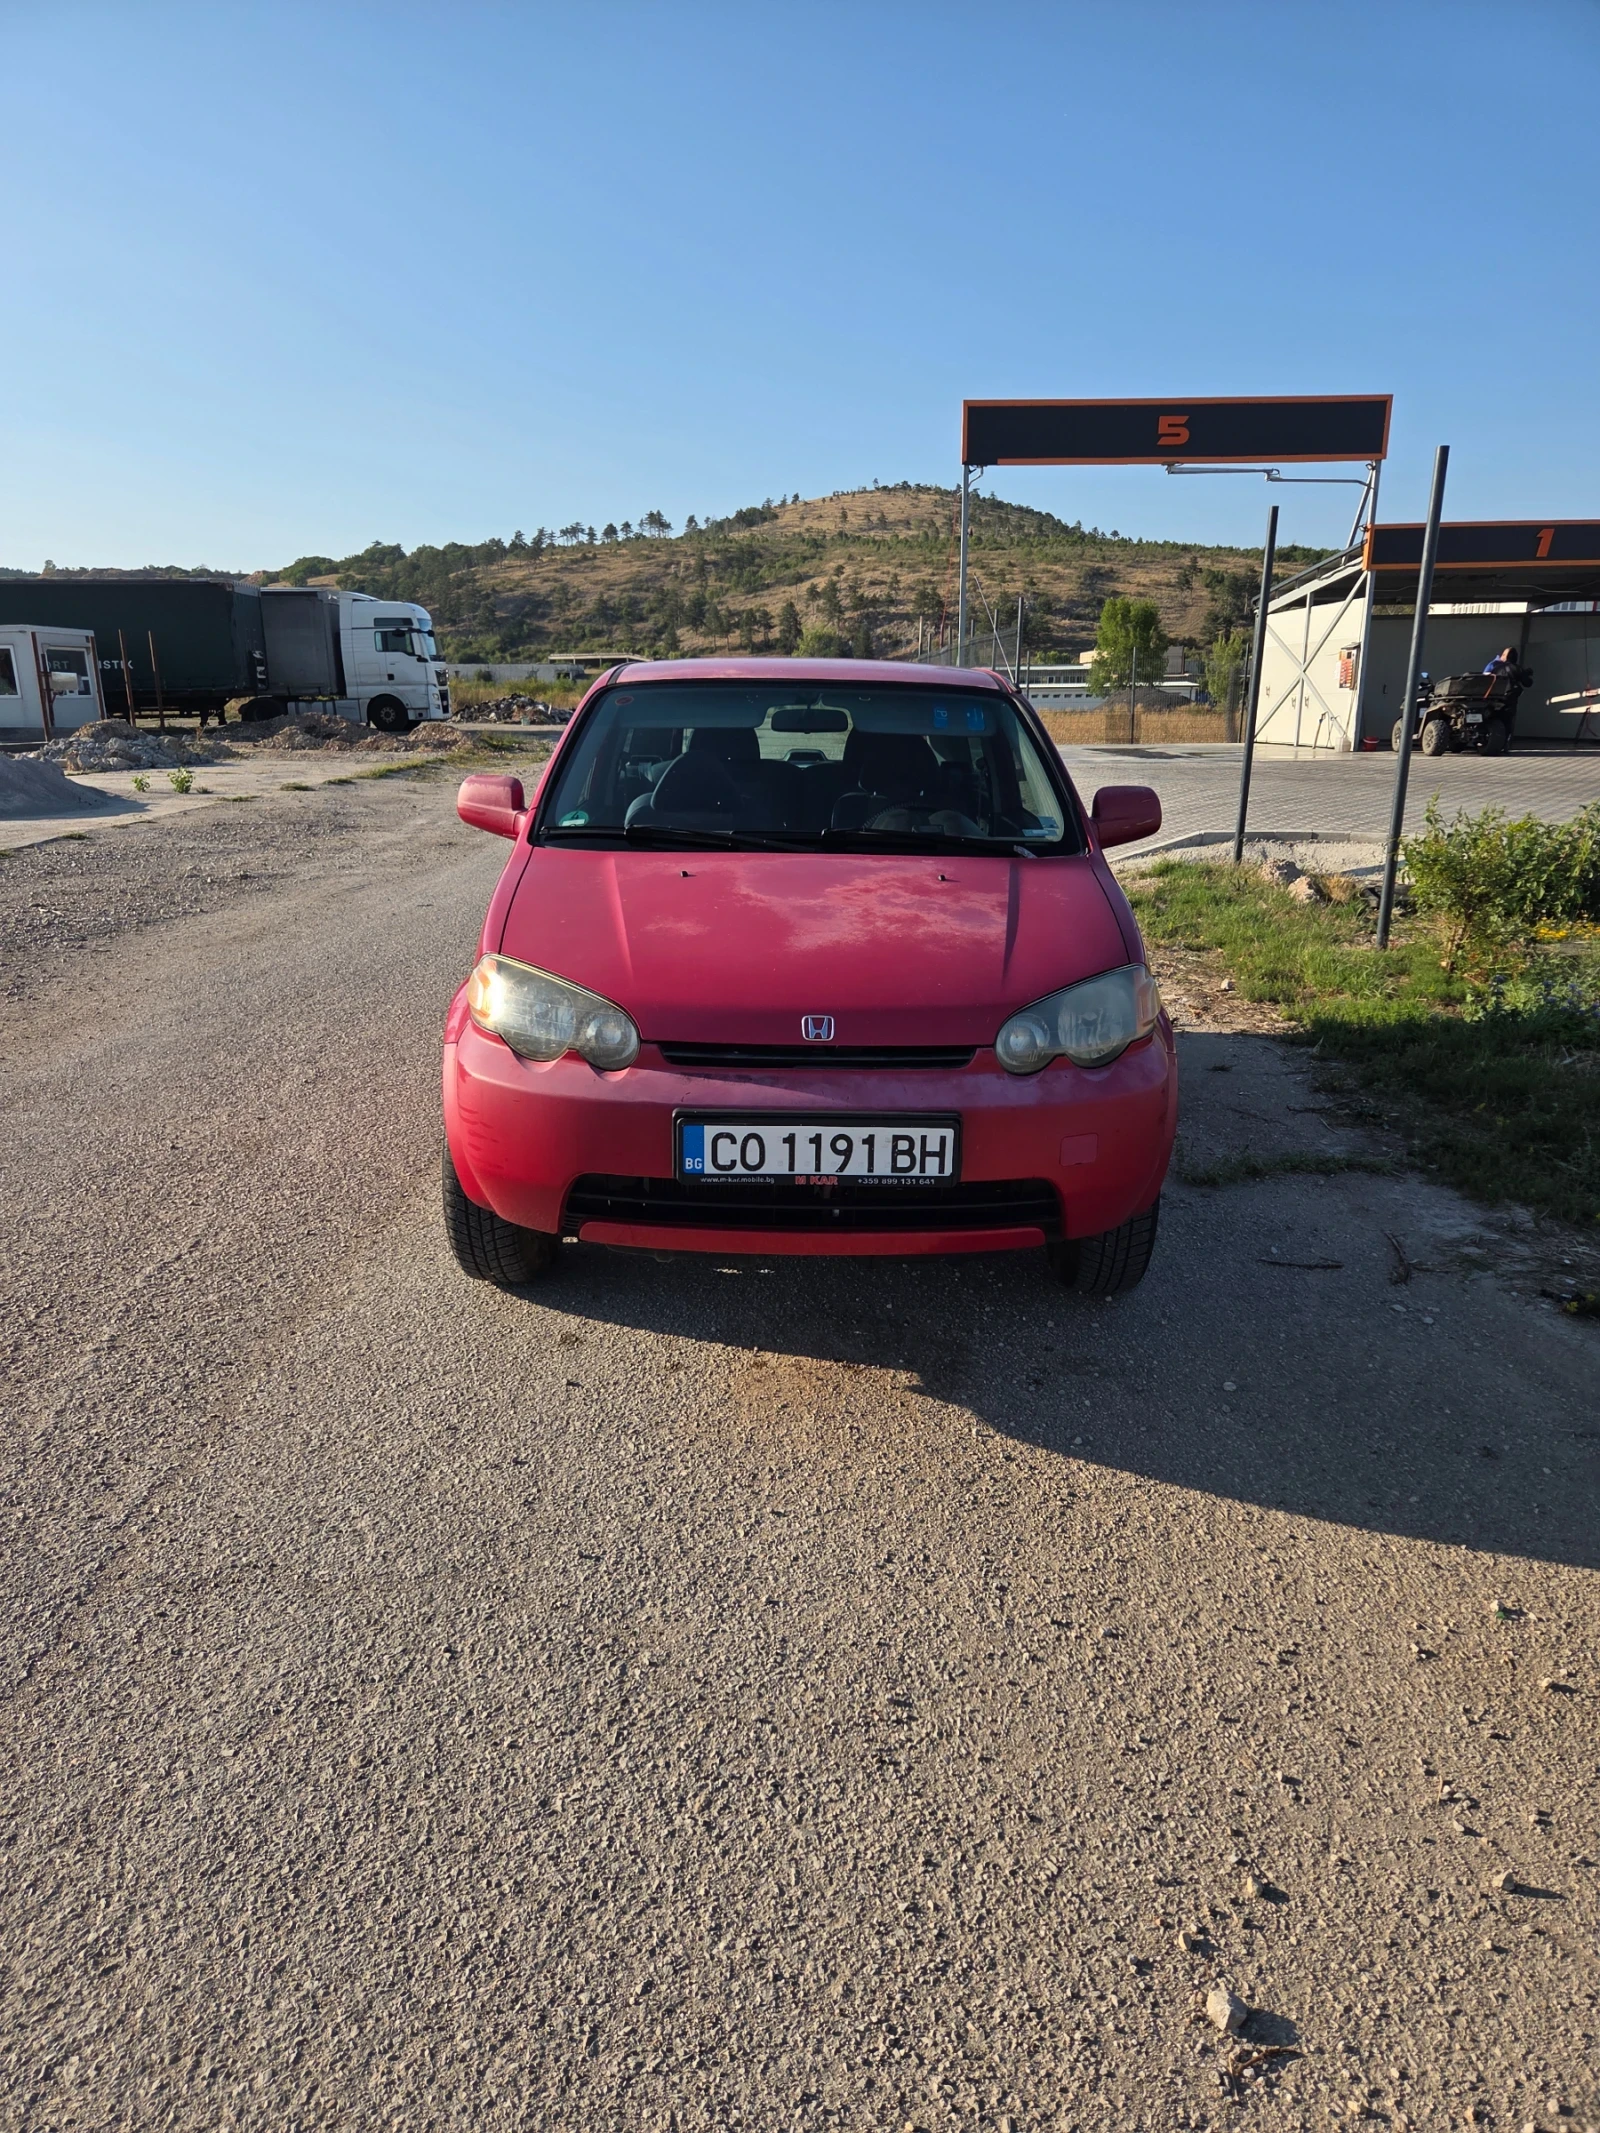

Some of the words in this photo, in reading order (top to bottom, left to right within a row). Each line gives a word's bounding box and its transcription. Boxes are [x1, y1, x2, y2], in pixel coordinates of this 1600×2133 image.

[1157, 415, 1190, 446] 5
[1536, 528, 1555, 558] 1
[686, 1158, 702, 1169] BG
[711, 1131, 766, 1172] CO
[782, 1132, 876, 1173] 1191
[890, 1134, 947, 1175] BH
[700, 1177, 775, 1185] www.m-kar.mobile.bg
[795, 1175, 806, 1185] M
[810, 1175, 838, 1185] KAR
[858, 1177, 879, 1185] +359
